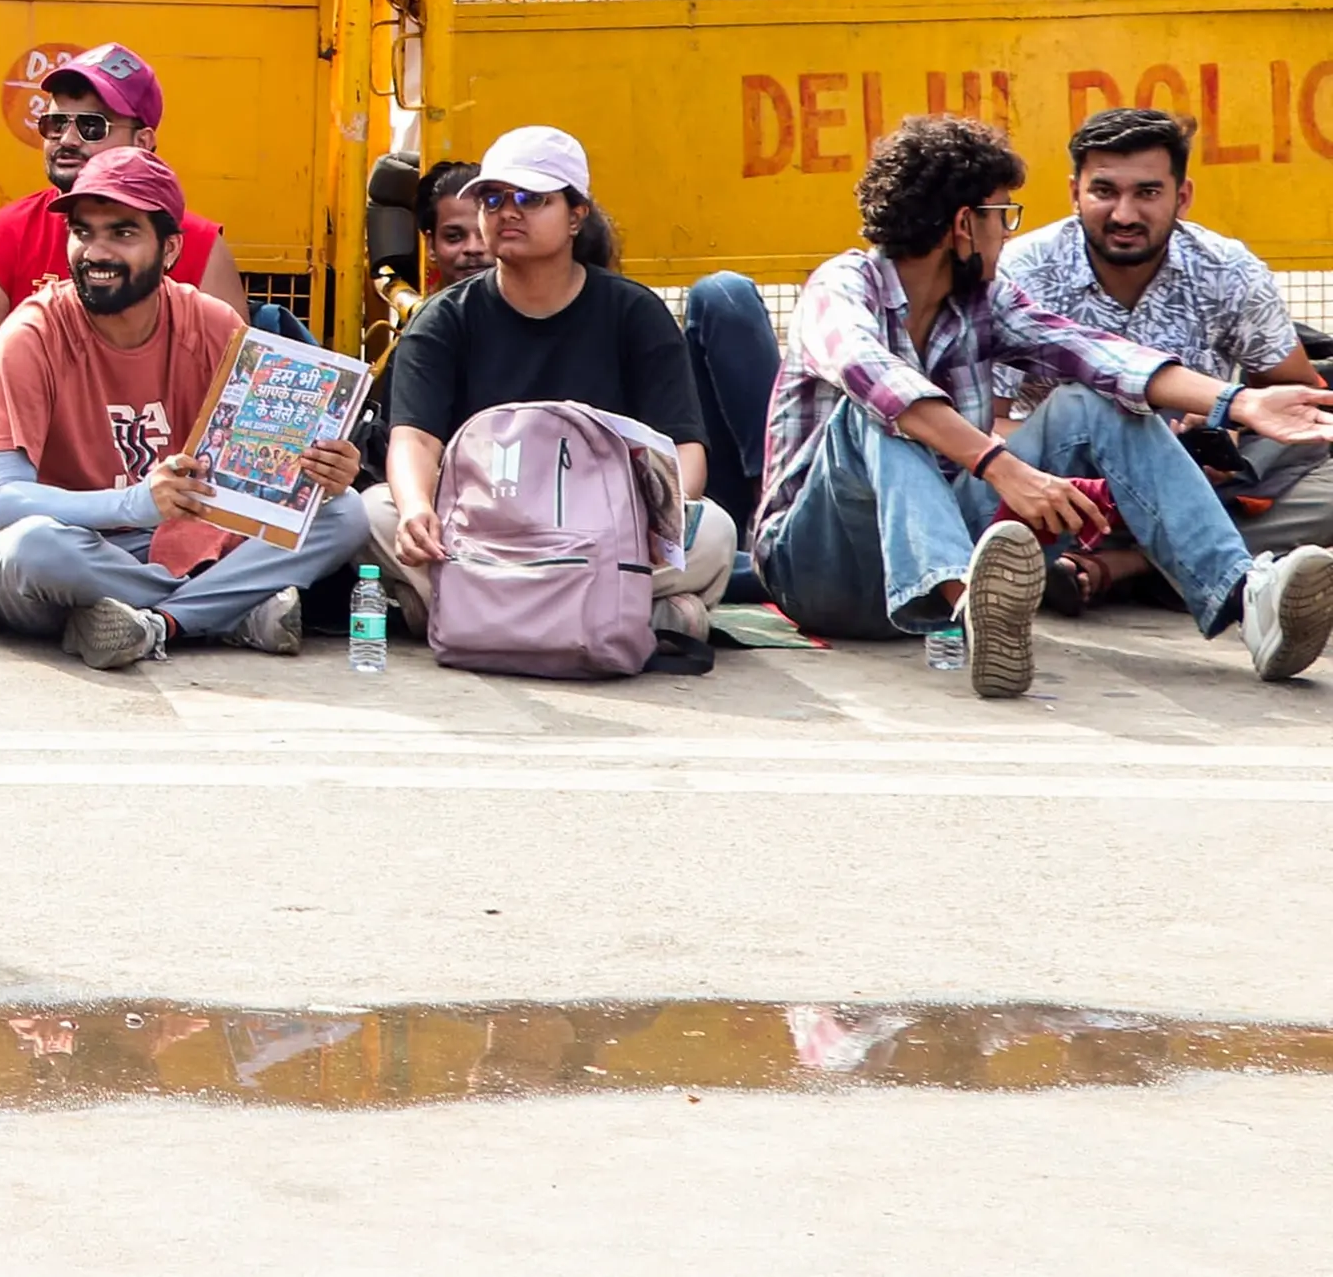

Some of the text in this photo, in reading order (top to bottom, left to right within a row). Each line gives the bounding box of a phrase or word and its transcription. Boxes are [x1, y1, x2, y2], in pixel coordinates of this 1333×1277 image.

[268, 367, 322, 390] हम भी
[253, 382, 292, 400] आपके
[255, 398, 271, 418] के
[270, 400, 295, 423] जैसे
